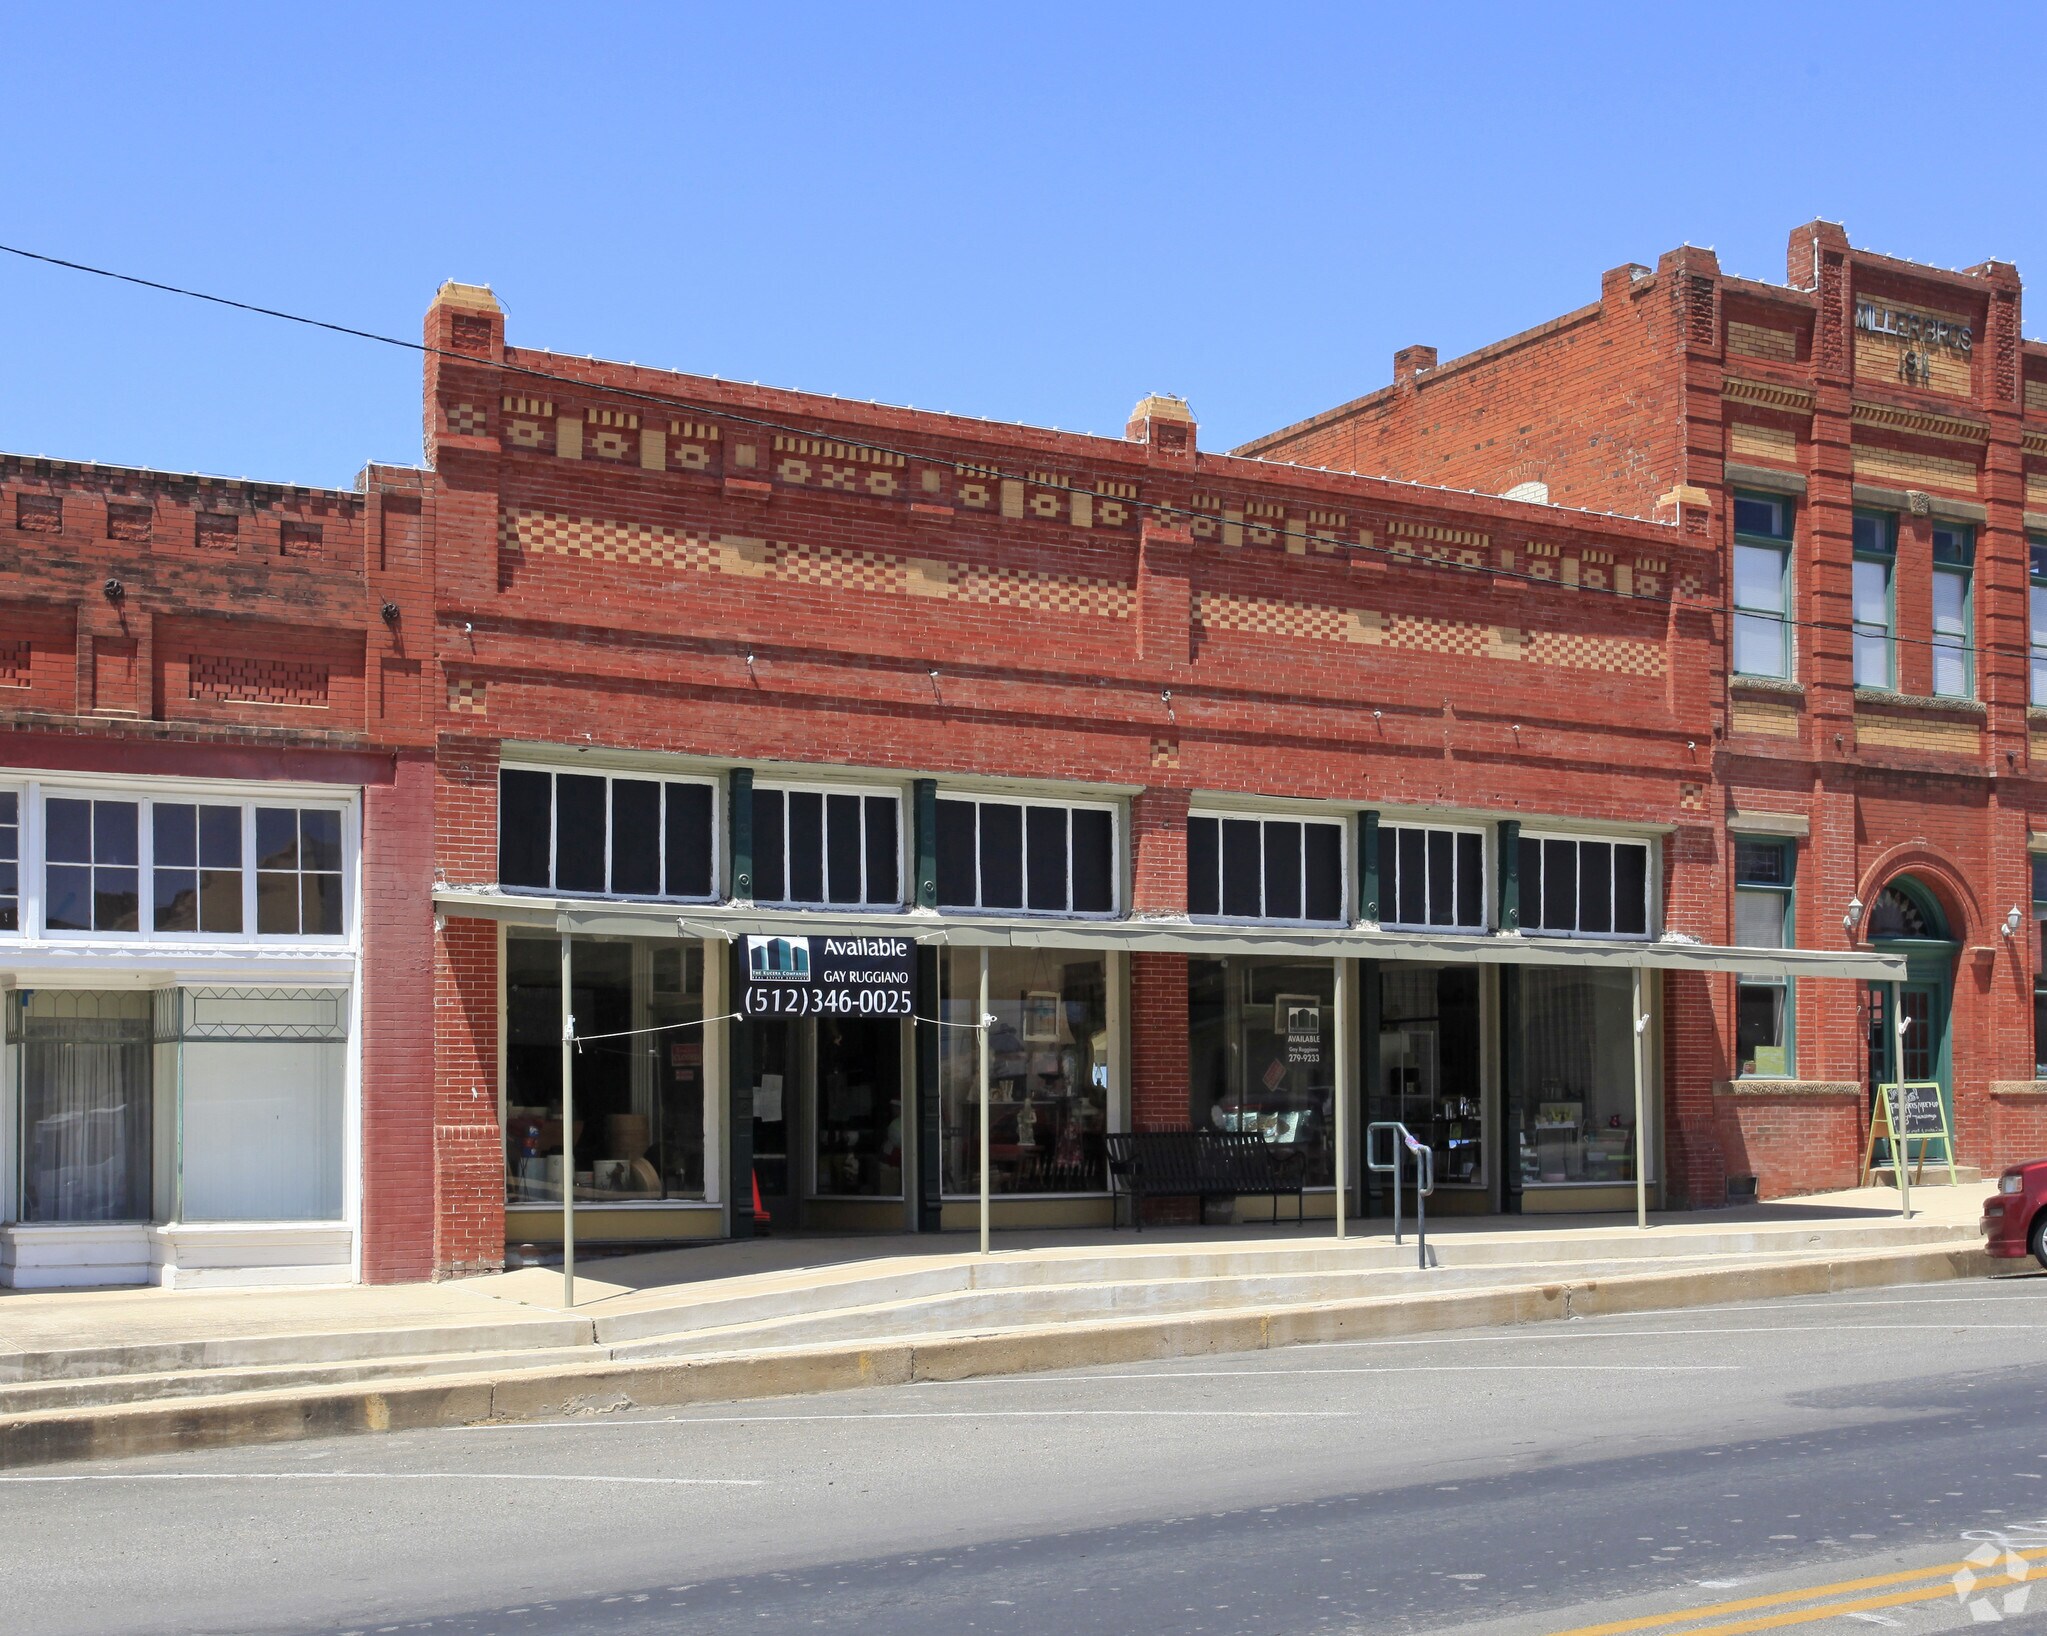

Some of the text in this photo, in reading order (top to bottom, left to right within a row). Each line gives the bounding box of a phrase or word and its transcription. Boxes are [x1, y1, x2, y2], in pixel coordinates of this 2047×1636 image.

[1855, 304, 1972, 351] MILLER BROS
[824, 938, 907, 957] Available
[824, 971, 909, 984] GAY RUGGIANO
[745, 986, 912, 1014] (512)346-0025
[1288, 1035, 1320, 1043] AVAILABLE
[1288, 1053, 1320, 1062] 279-9233
